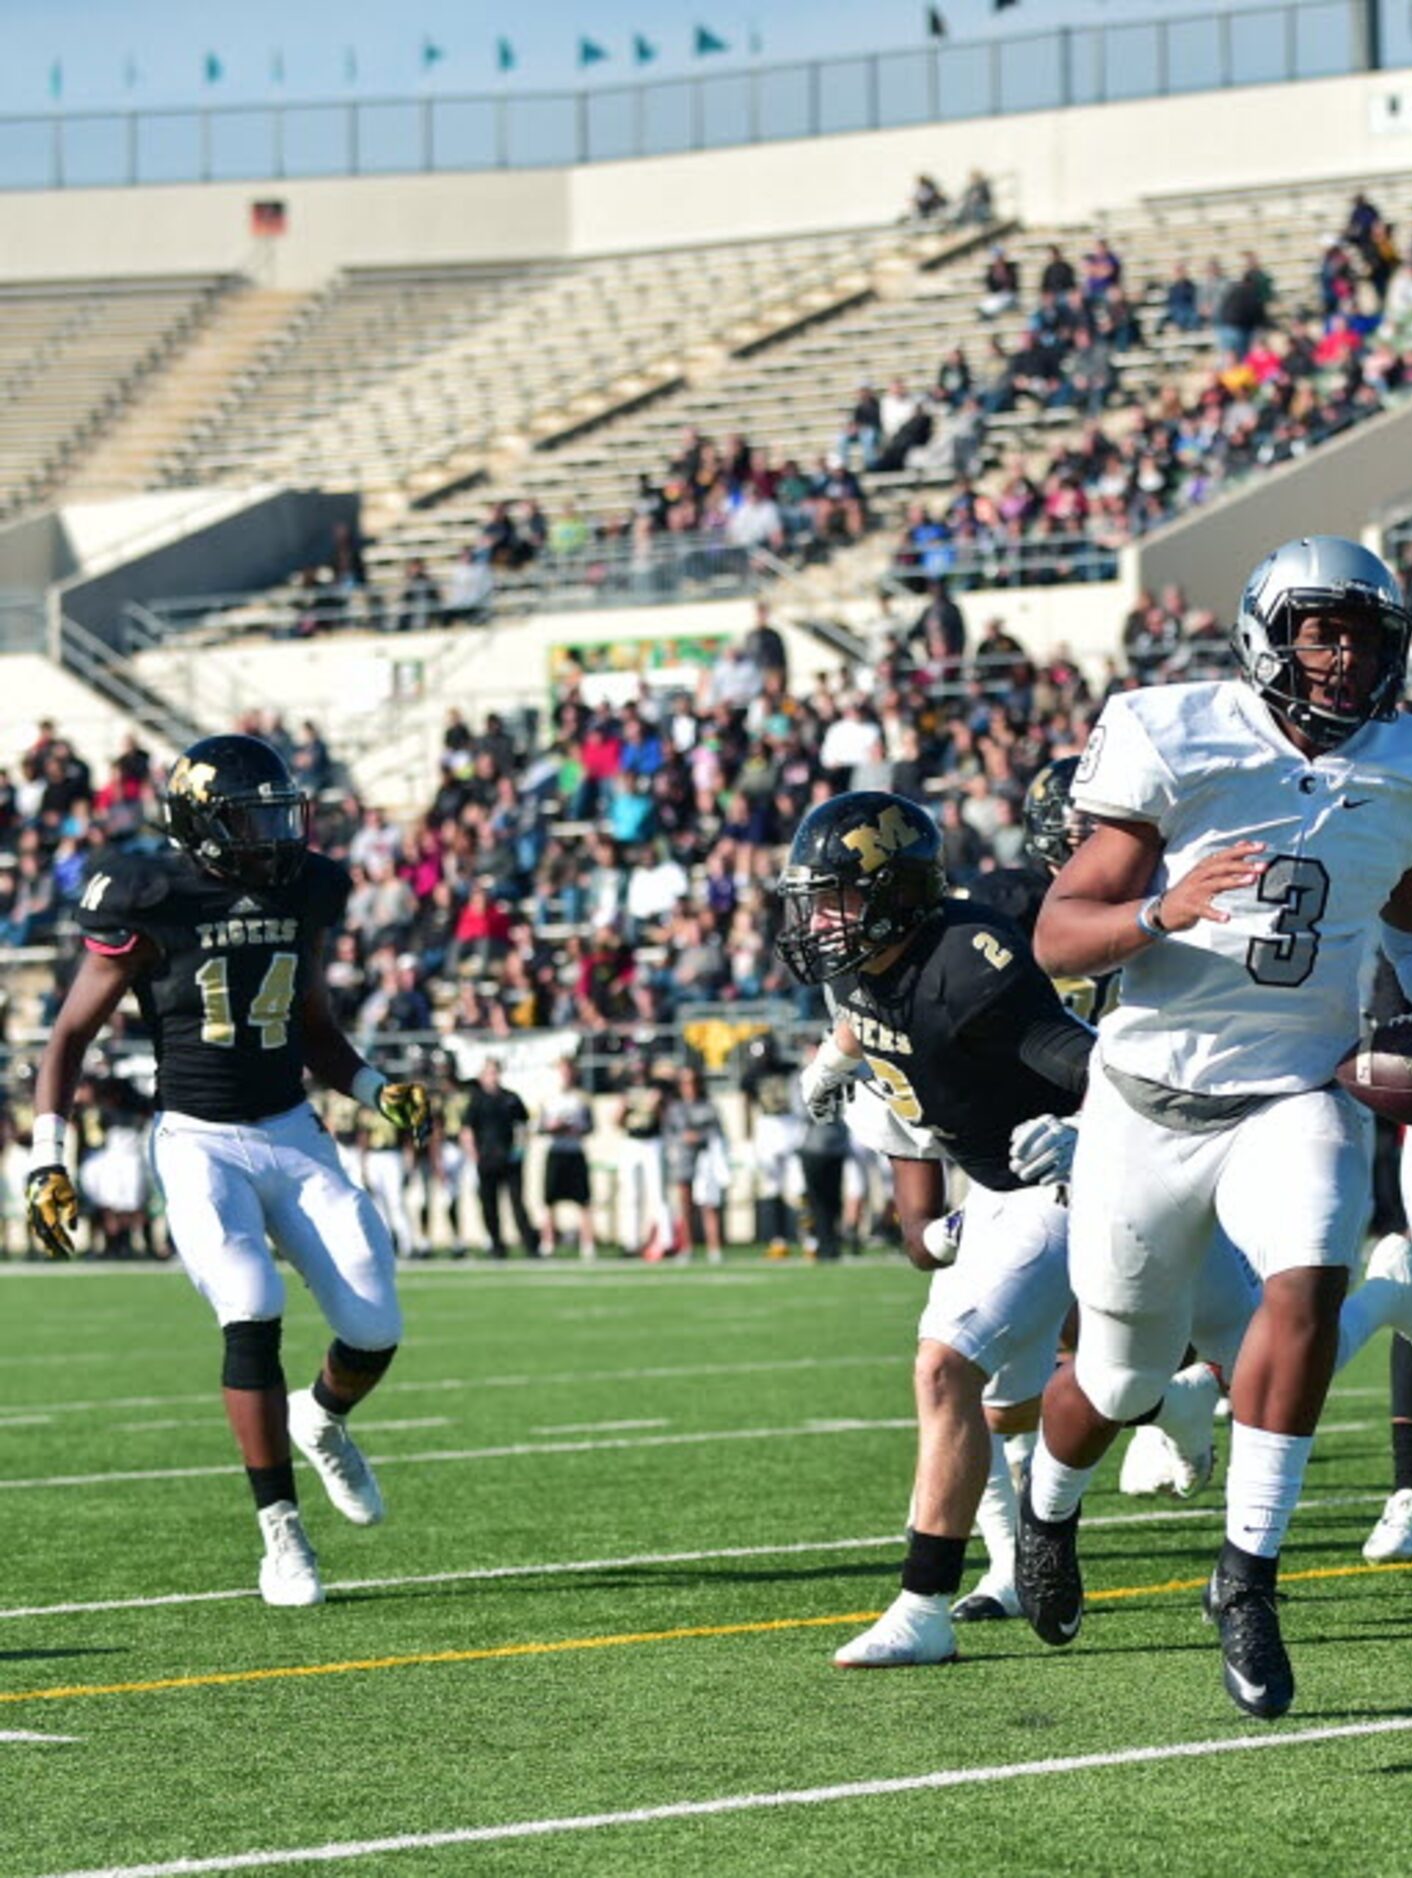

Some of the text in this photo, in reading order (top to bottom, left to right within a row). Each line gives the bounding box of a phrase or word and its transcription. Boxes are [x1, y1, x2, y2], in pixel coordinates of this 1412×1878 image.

[195, 919, 298, 950] TIGERS
[973, 931, 1014, 970] 2
[1246, 854, 1330, 987] 3
[196, 952, 298, 1049] 14
